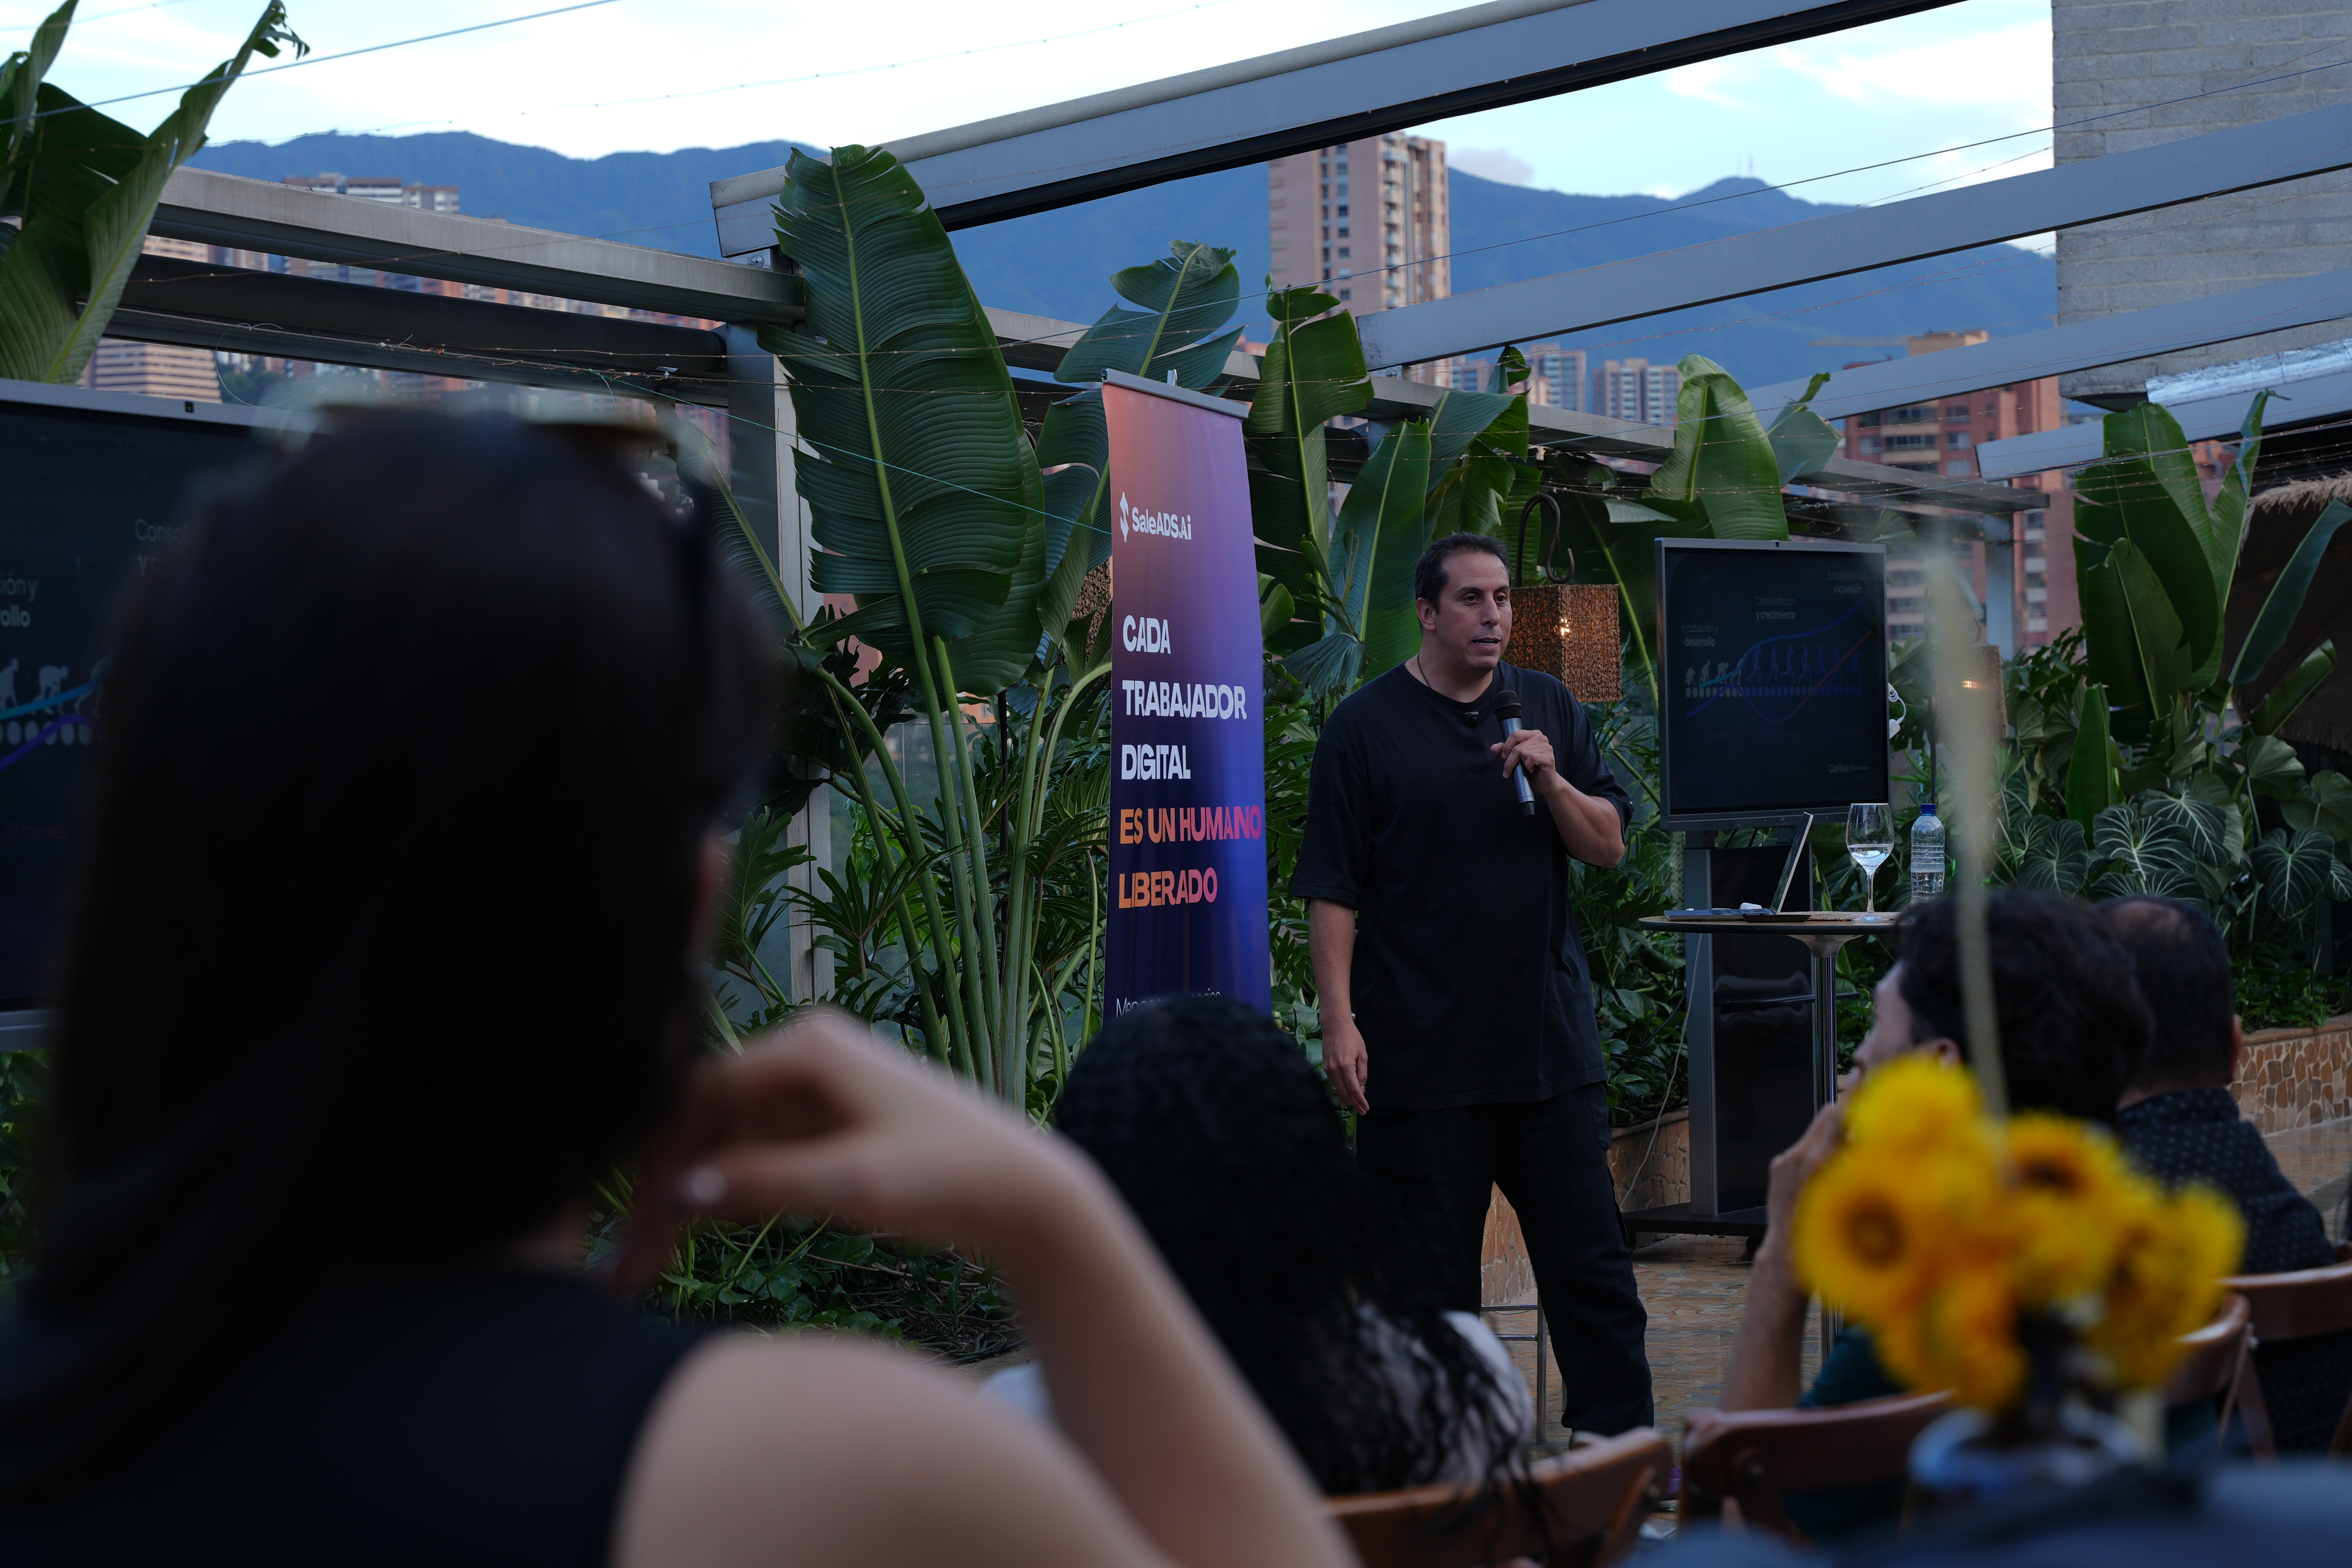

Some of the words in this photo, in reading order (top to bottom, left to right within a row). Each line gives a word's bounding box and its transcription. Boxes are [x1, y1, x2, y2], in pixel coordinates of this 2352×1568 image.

[1132, 506, 1192, 540] SaleADS.Ai
[27, 580, 38, 602] y
[1755, 596, 1796, 606] Consolidación
[1834, 584, 1862, 595] expansión
[0, 603, 31, 628] ollo
[1756, 612, 1761, 621] y
[1761, 611, 1796, 620] crecimiento
[1123, 615, 1171, 654] CADA
[1681, 622, 1714, 633] Incubación
[1714, 624, 1718, 635] y
[1685, 636, 1715, 646] desarrollo
[1122, 680, 1247, 720] TRABAJADOR
[1121, 743, 1191, 780] DIGITAL
[1829, 764, 1849, 773] Coffee
[1120, 808, 1144, 844] ES
[1148, 808, 1176, 843] UN
[1179, 805, 1262, 842] HUMANO
[1119, 867, 1218, 909] LIBERADO
